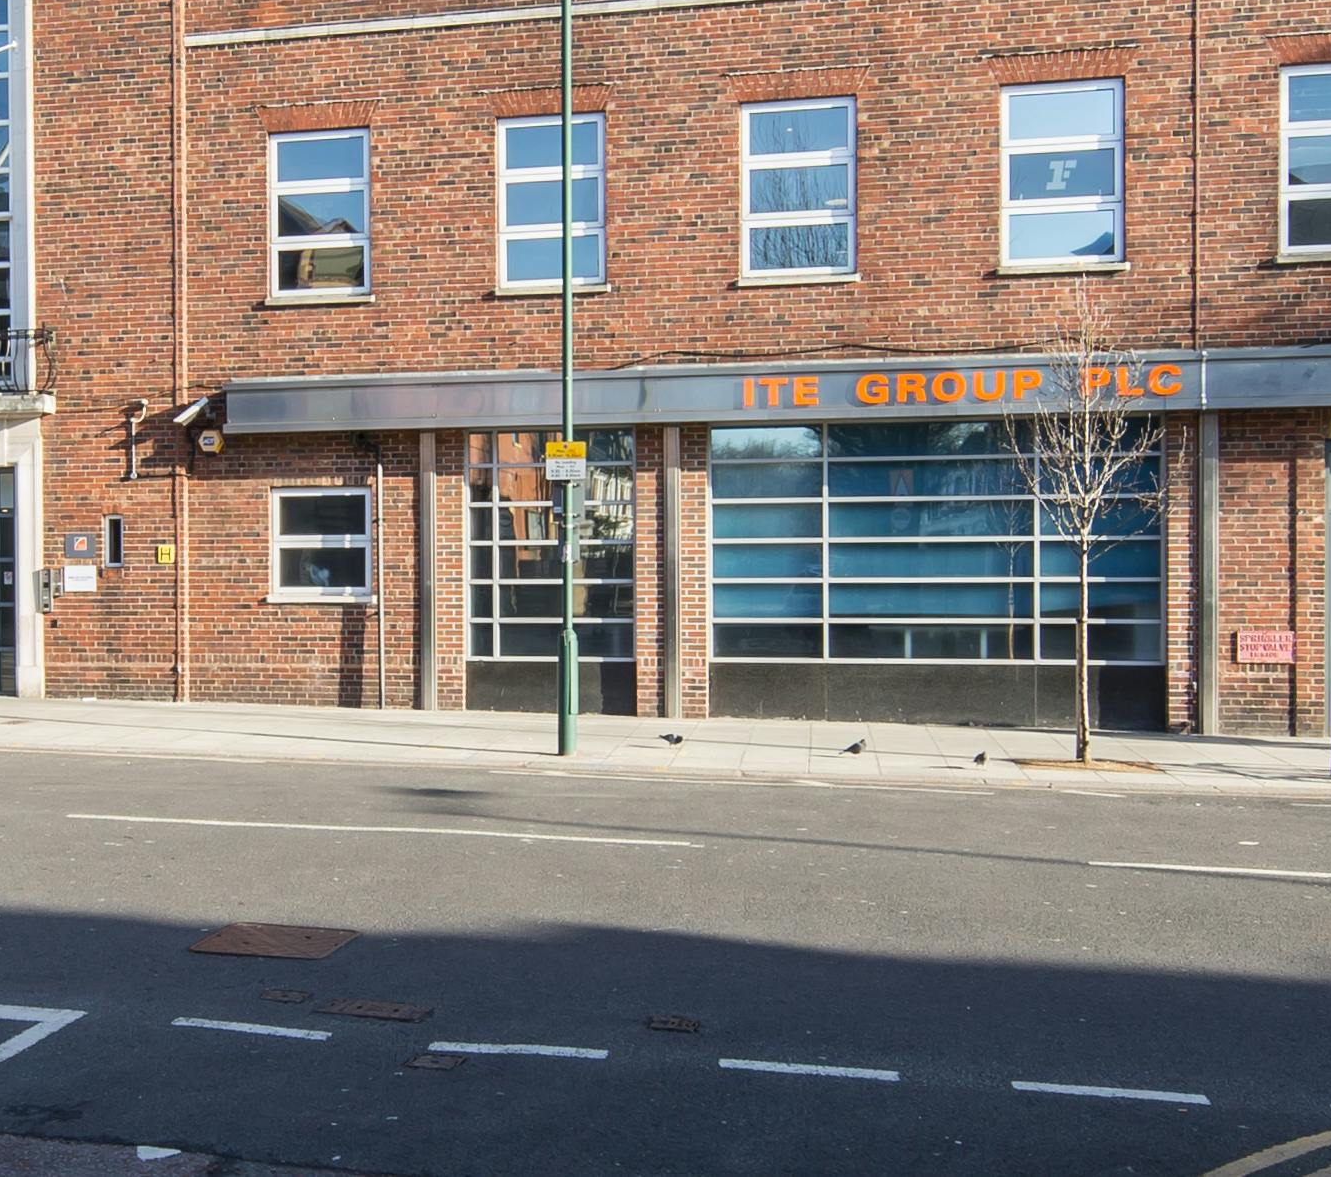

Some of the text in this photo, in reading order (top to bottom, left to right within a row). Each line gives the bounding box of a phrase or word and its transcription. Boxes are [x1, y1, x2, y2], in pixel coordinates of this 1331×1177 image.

[741, 363, 1183, 407] ITE GROUP PLC
